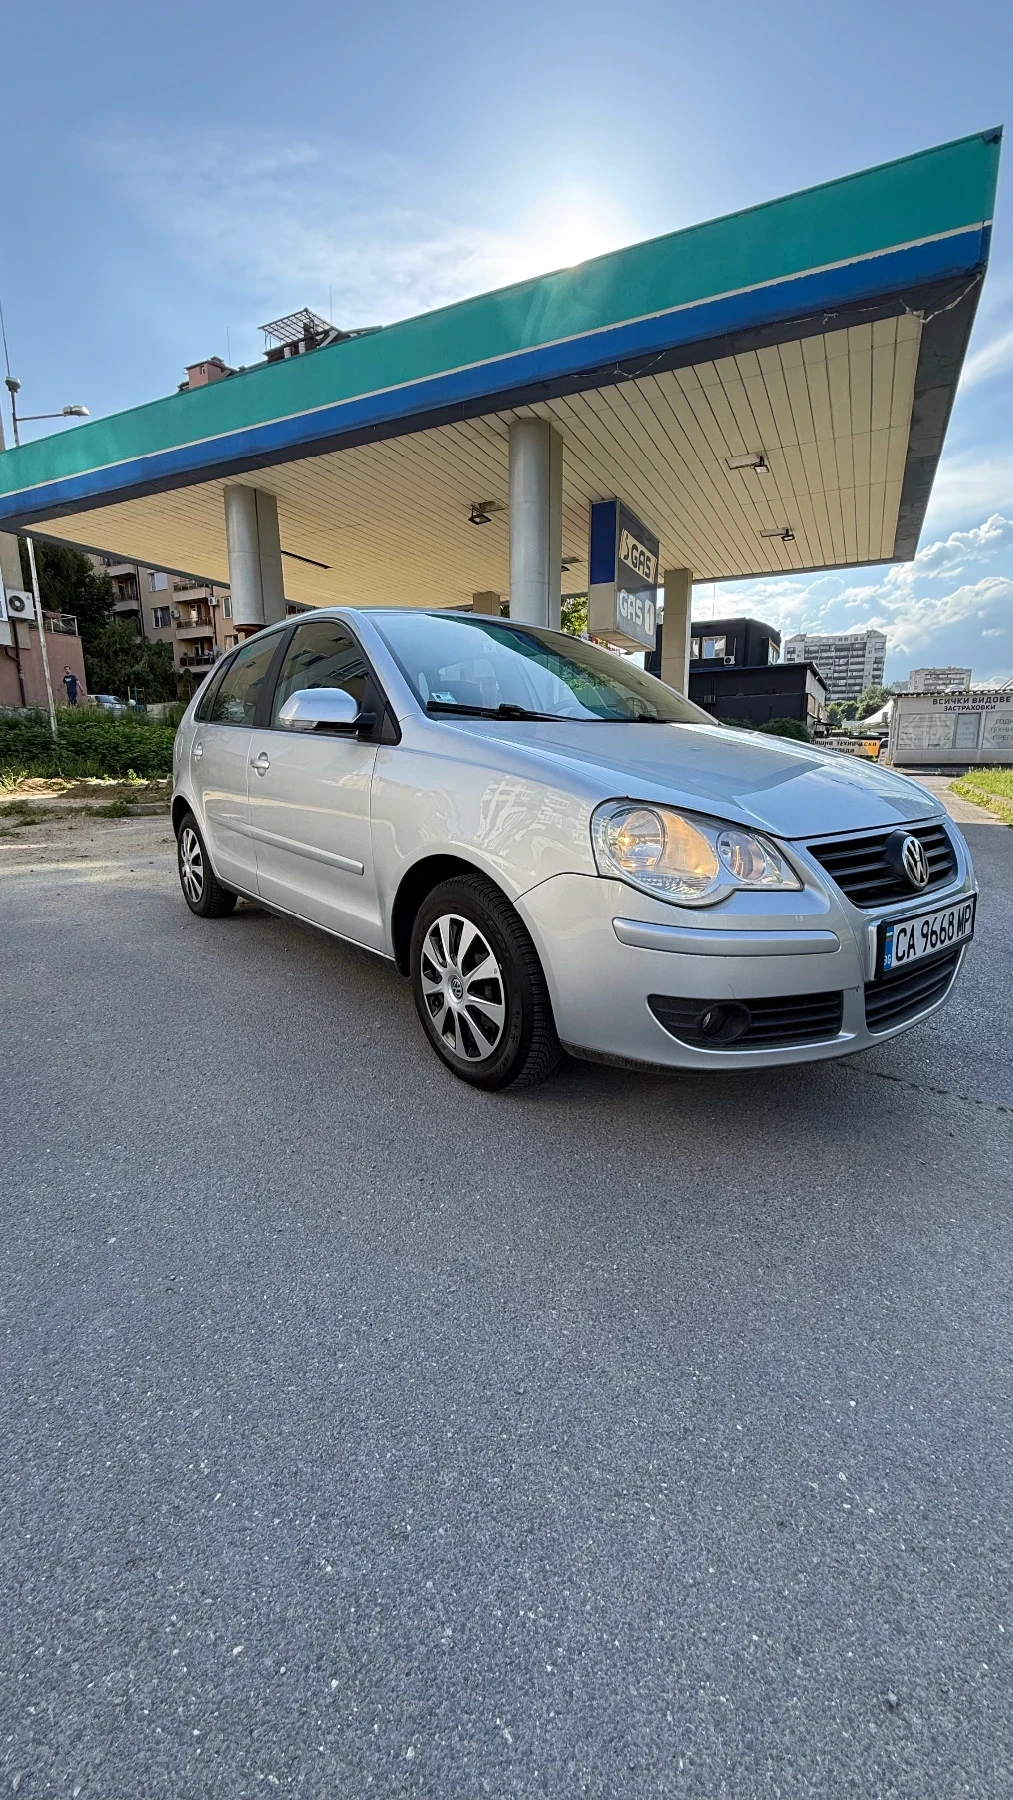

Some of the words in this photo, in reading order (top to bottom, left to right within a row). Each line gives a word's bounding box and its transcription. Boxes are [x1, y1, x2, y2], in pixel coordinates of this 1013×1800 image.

[631, 543, 651, 579] GAS
[619, 588, 642, 626] GAS
[932, 697, 970, 705] ВСИЧКИ
[972, 696, 1012, 704] ВИДОВЕ
[895, 924, 917, 962] CA
[921, 911, 955, 953] 9668
[957, 904, 971, 938] MP
